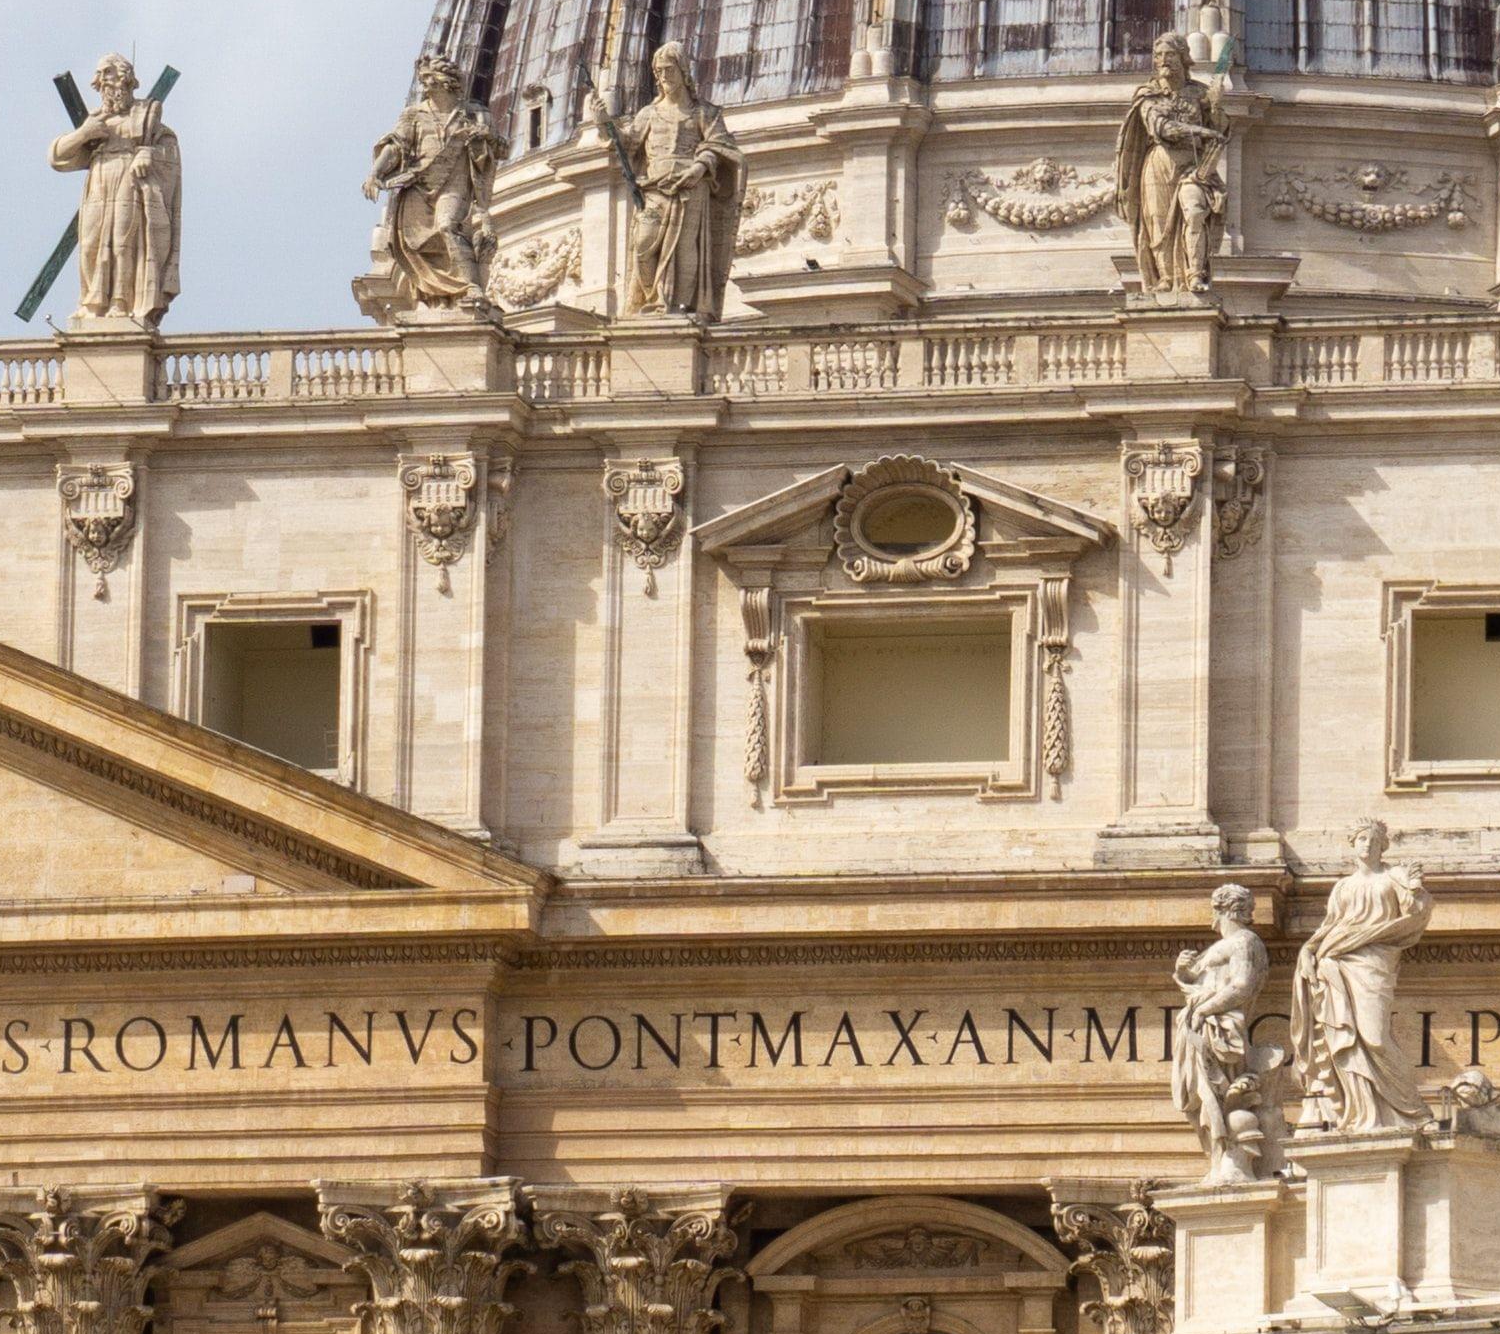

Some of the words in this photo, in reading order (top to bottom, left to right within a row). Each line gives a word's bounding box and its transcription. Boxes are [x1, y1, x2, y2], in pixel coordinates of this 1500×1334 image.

[57, 1007, 480, 1075] ROMANVS
[519, 1009, 738, 1072] PONT
[743, 1009, 932, 1069] MAX
[938, 1005, 1061, 1066] AN
